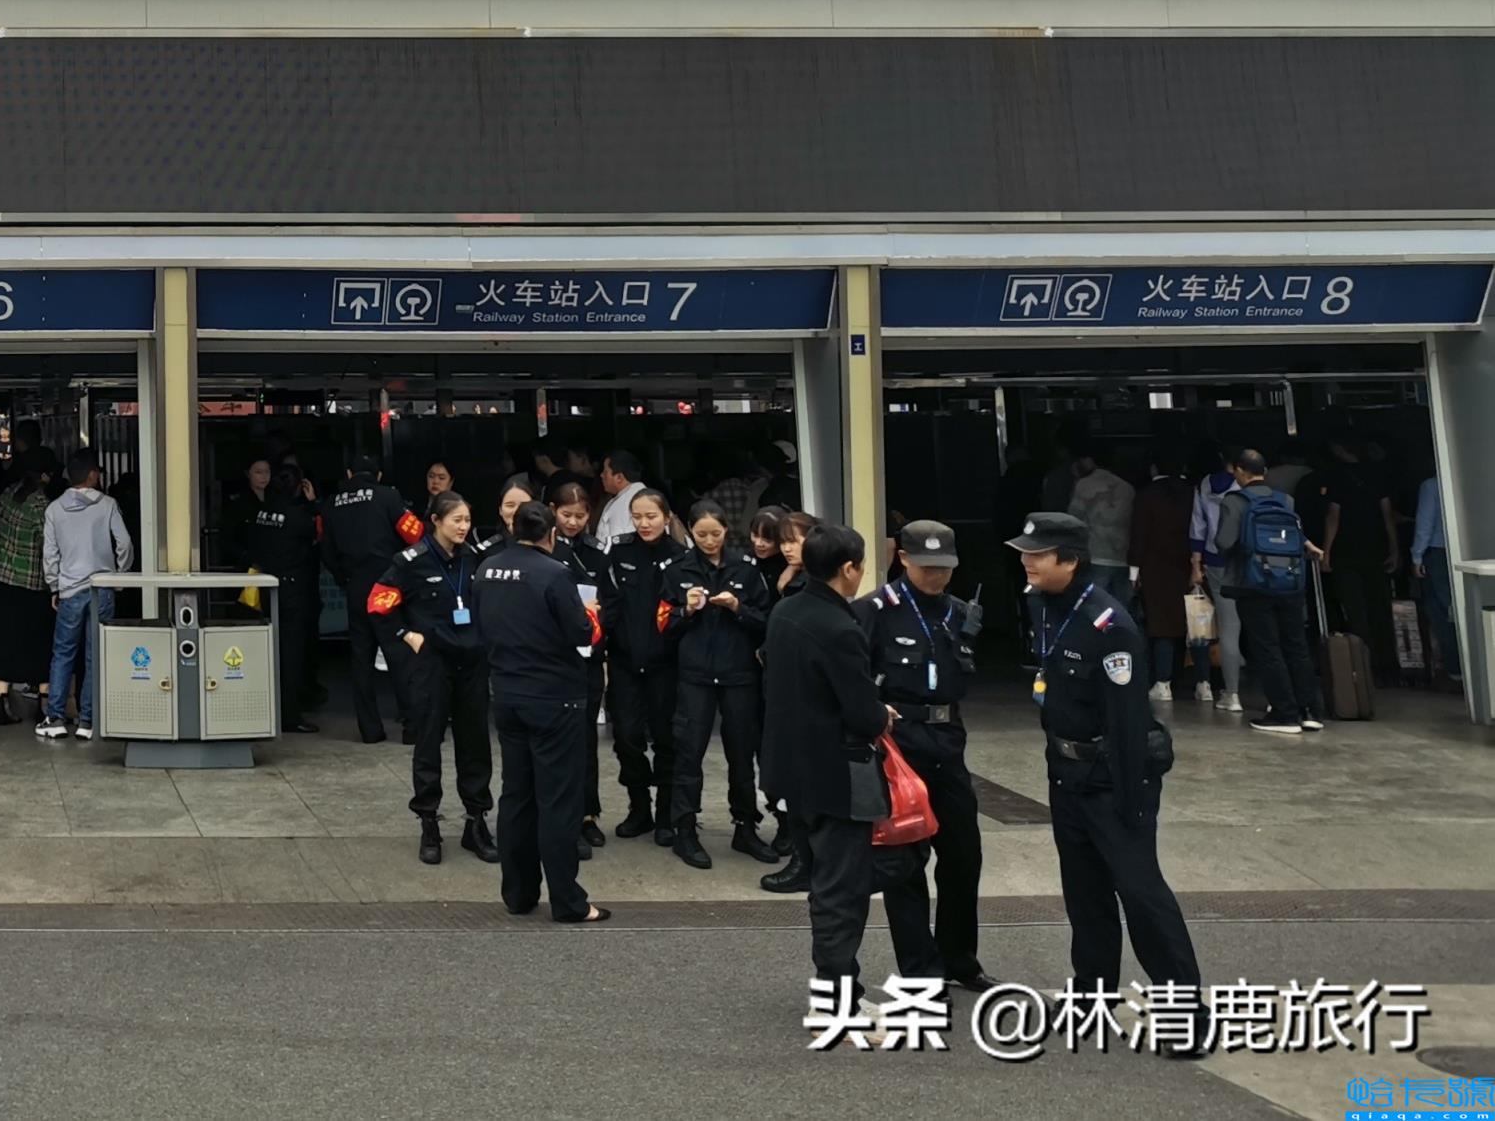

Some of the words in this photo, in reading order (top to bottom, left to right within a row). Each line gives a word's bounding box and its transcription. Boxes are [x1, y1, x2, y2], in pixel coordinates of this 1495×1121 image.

[475, 278, 651, 307] 火车站入口
[666, 282, 698, 321] 7
[1142, 274, 1311, 302] 火车站入口
[1320, 276, 1354, 315] 8
[473, 311, 525, 324] Railway
[532, 311, 579, 323] Station
[586, 311, 646, 323] Entrance
[1137, 306, 1188, 319] Railway
[1194, 306, 1239, 317] Station
[1245, 306, 1303, 317] Entrance
